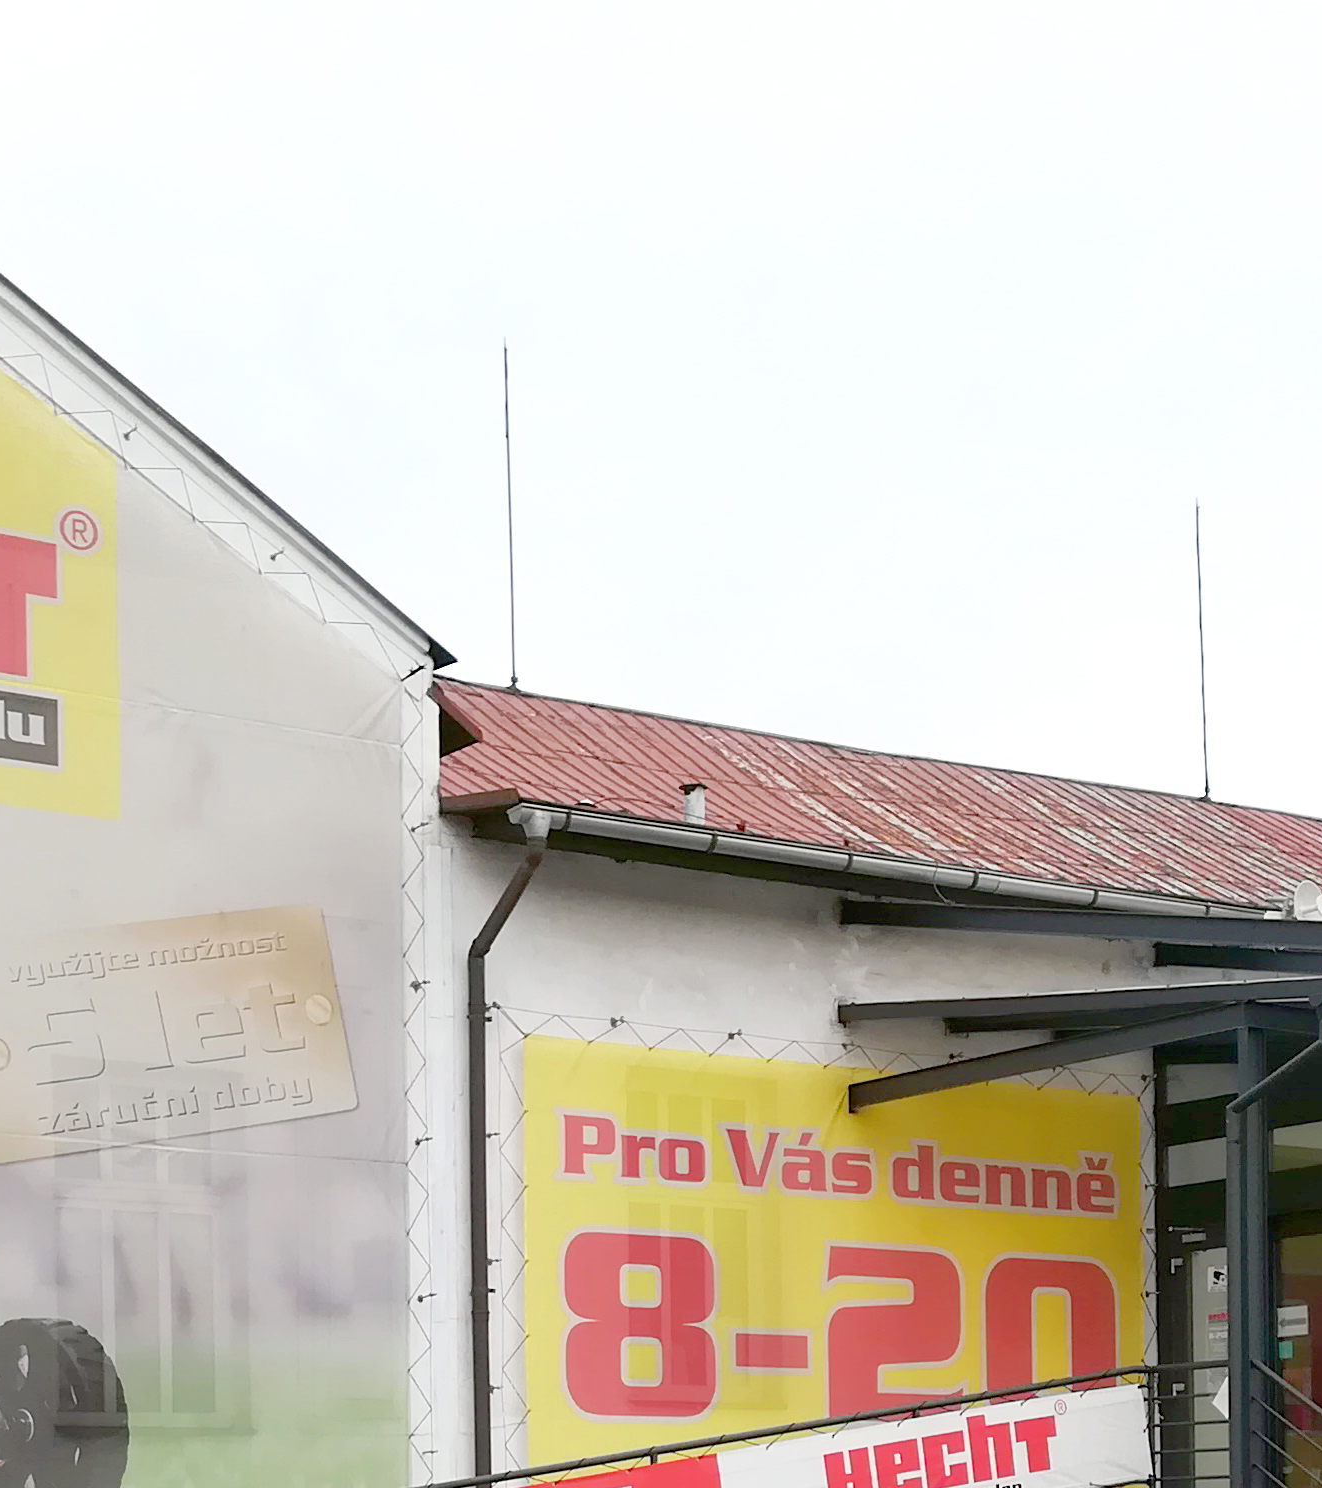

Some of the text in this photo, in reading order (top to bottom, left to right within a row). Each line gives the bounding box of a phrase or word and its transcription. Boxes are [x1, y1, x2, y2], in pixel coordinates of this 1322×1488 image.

[8, 932, 288, 987] využijte možnost
[139, 981, 307, 1073] let
[37, 1075, 315, 1137] záruční doby
[562, 1113, 1116, 1215] Pro Vás denně
[563, 1231, 1118, 1420] 8-20
